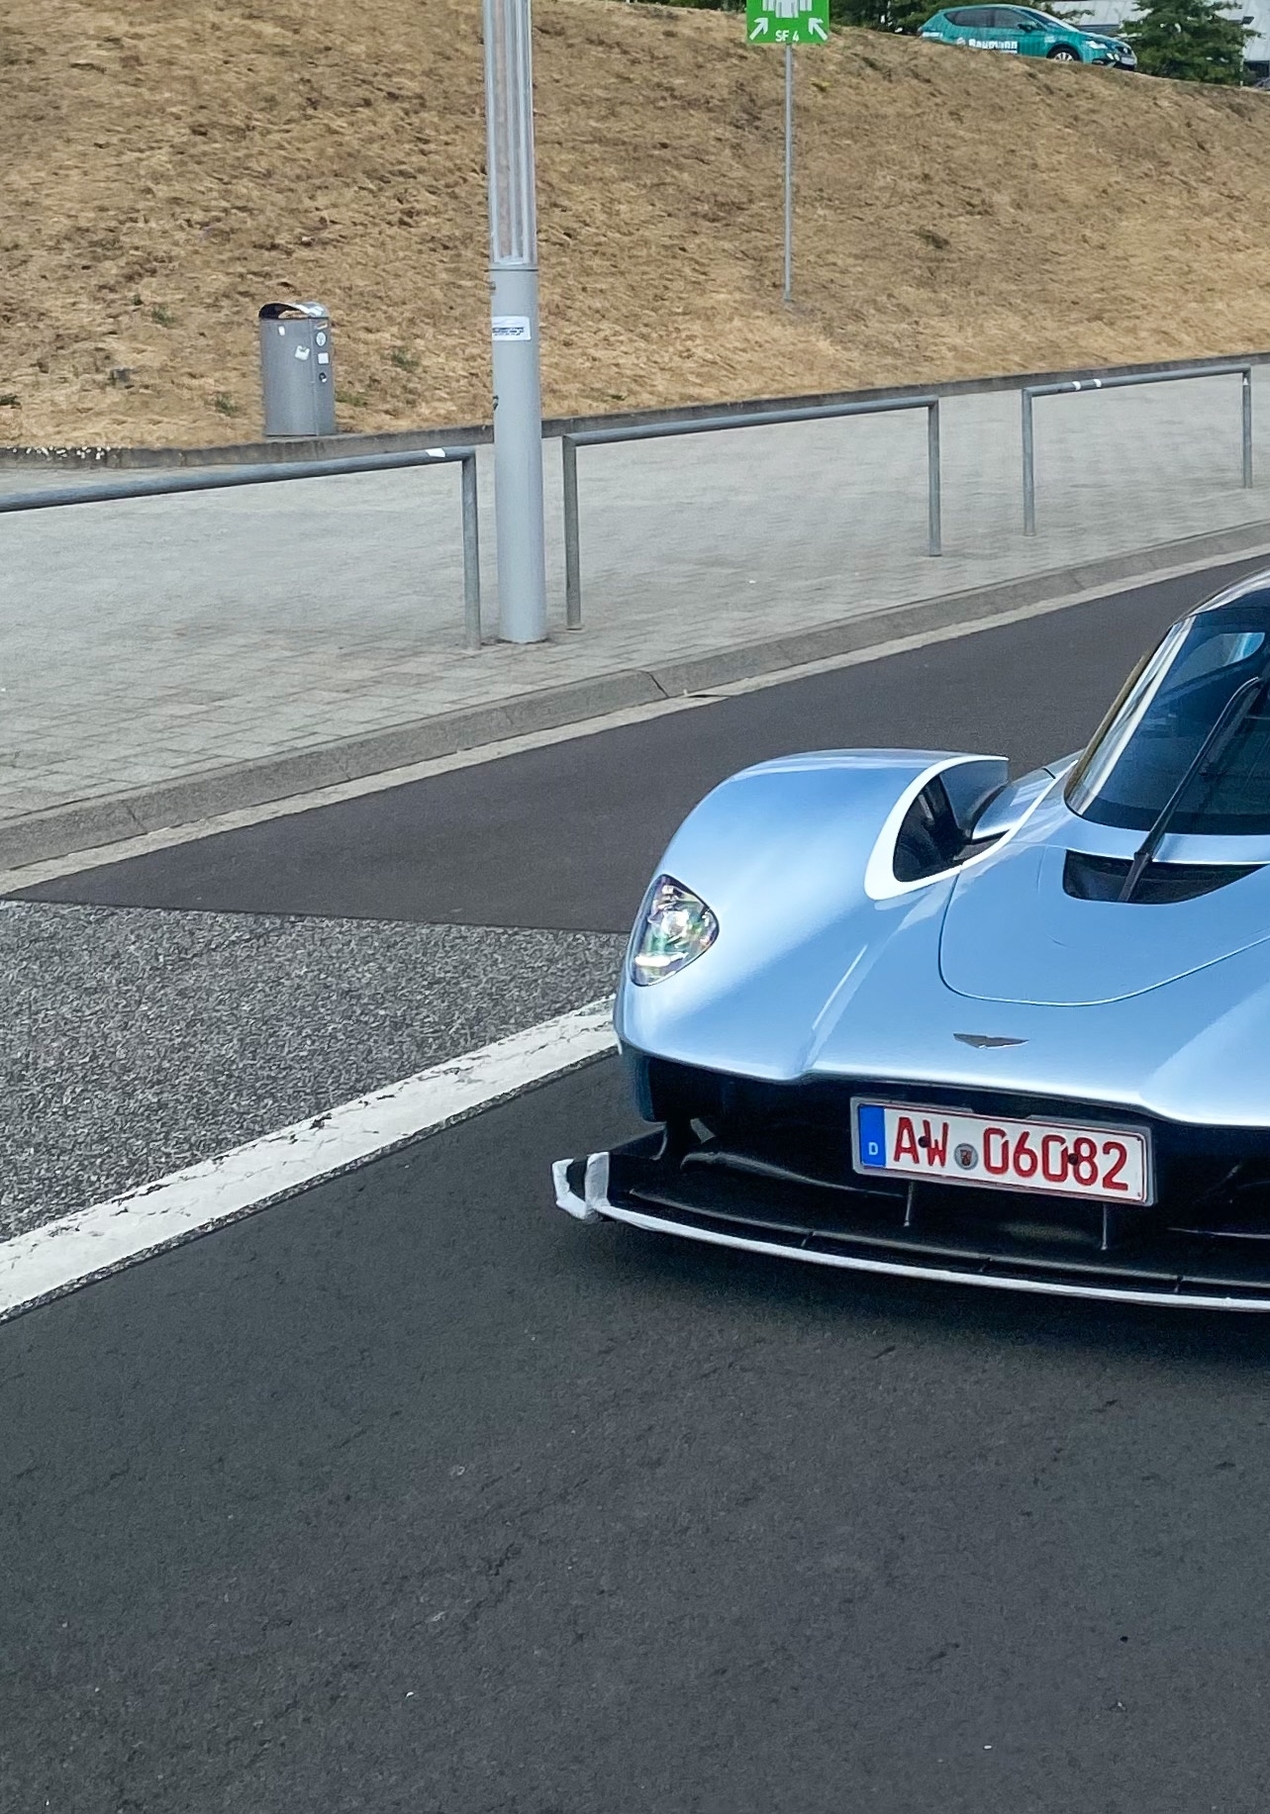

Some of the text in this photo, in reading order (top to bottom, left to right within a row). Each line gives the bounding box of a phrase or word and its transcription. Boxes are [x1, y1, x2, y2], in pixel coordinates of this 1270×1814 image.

[775, 30, 800, 42] SF 4
[868, 1141, 879, 1156] D
[893, 1116, 1129, 1191] AW 06082
